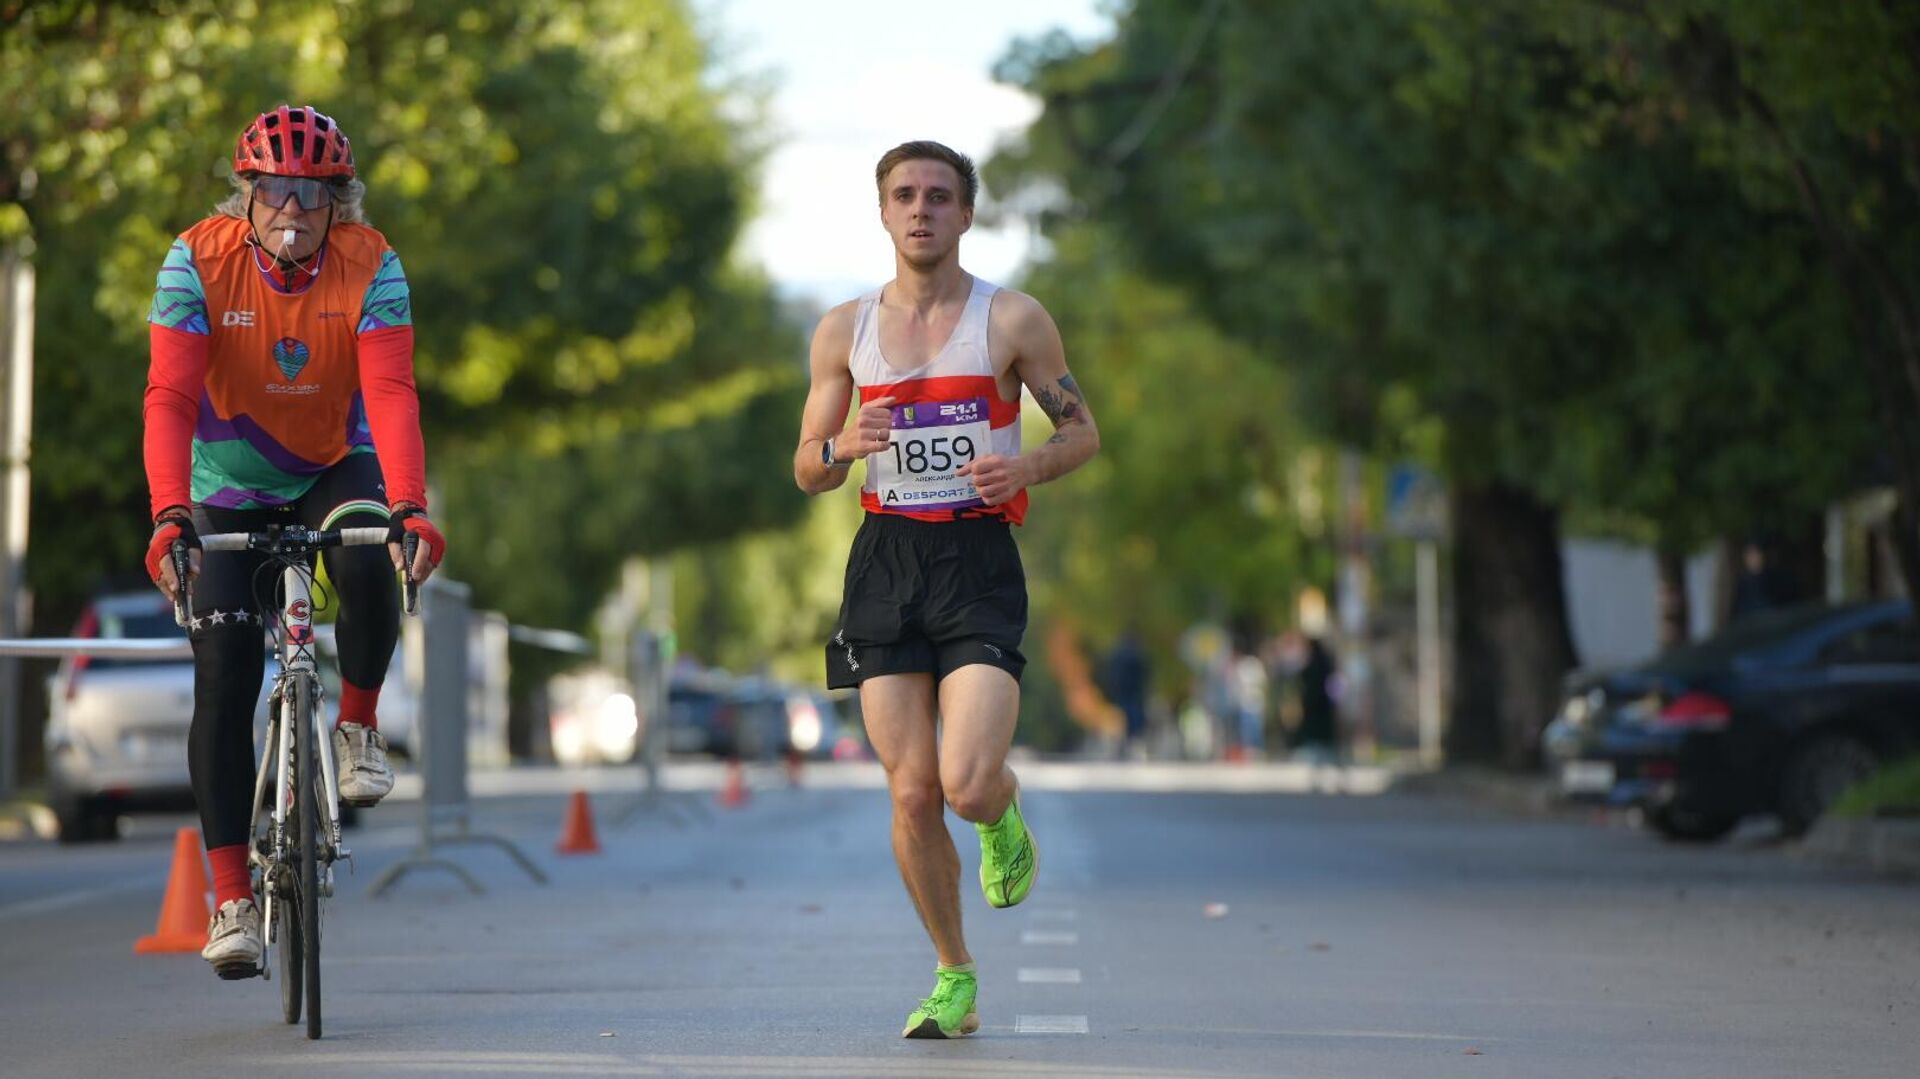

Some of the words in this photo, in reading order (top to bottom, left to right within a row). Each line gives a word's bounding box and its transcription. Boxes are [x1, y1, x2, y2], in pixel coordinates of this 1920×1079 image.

[940, 403, 977, 416] 21.1
[890, 436, 975, 474] 1859
[903, 488, 964, 500] DESPORT
